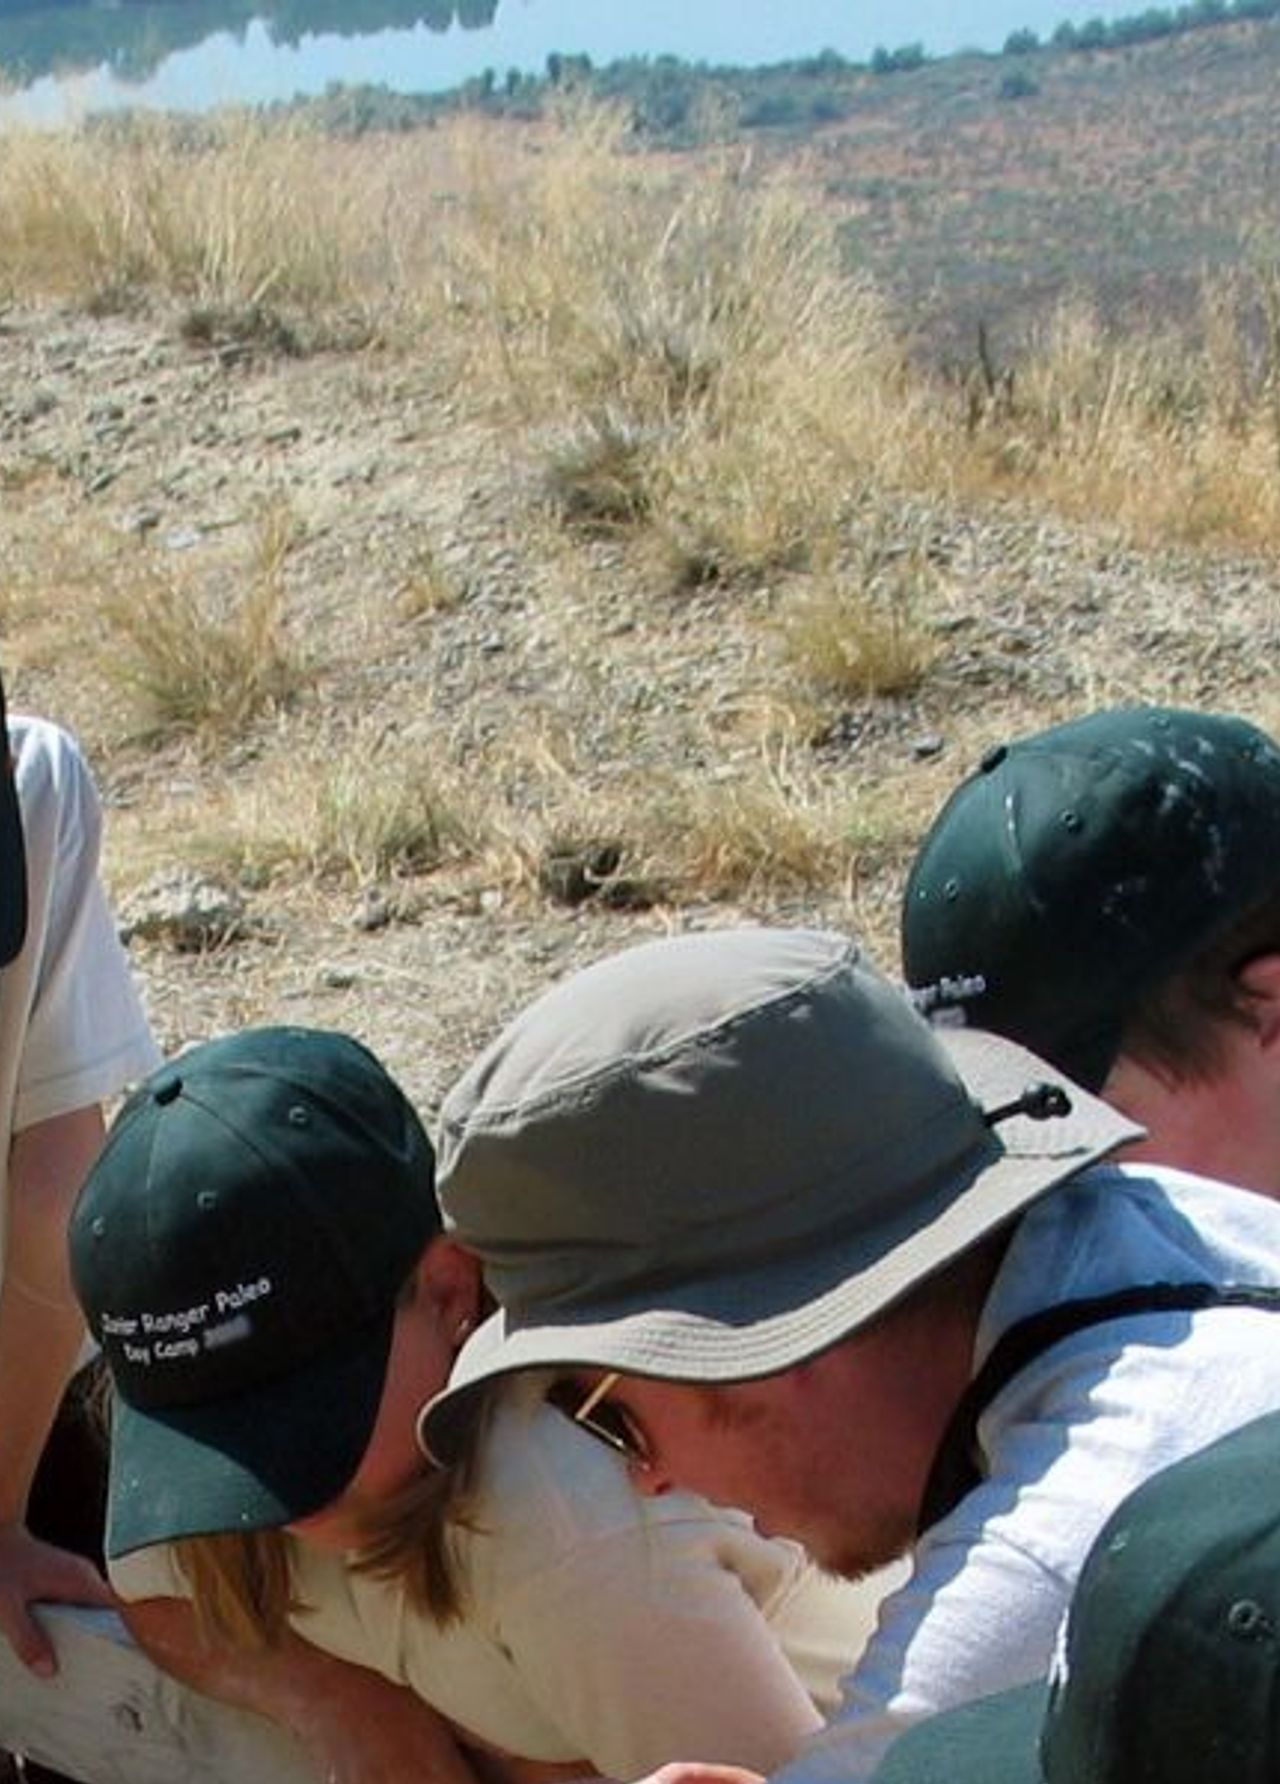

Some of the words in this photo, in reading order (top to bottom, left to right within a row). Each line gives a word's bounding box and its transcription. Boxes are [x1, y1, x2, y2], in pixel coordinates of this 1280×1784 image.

[141, 1304, 209, 1333] Ranger
[215, 1277, 272, 1314] Paleo
[154, 1338, 199, 1359] Camp
